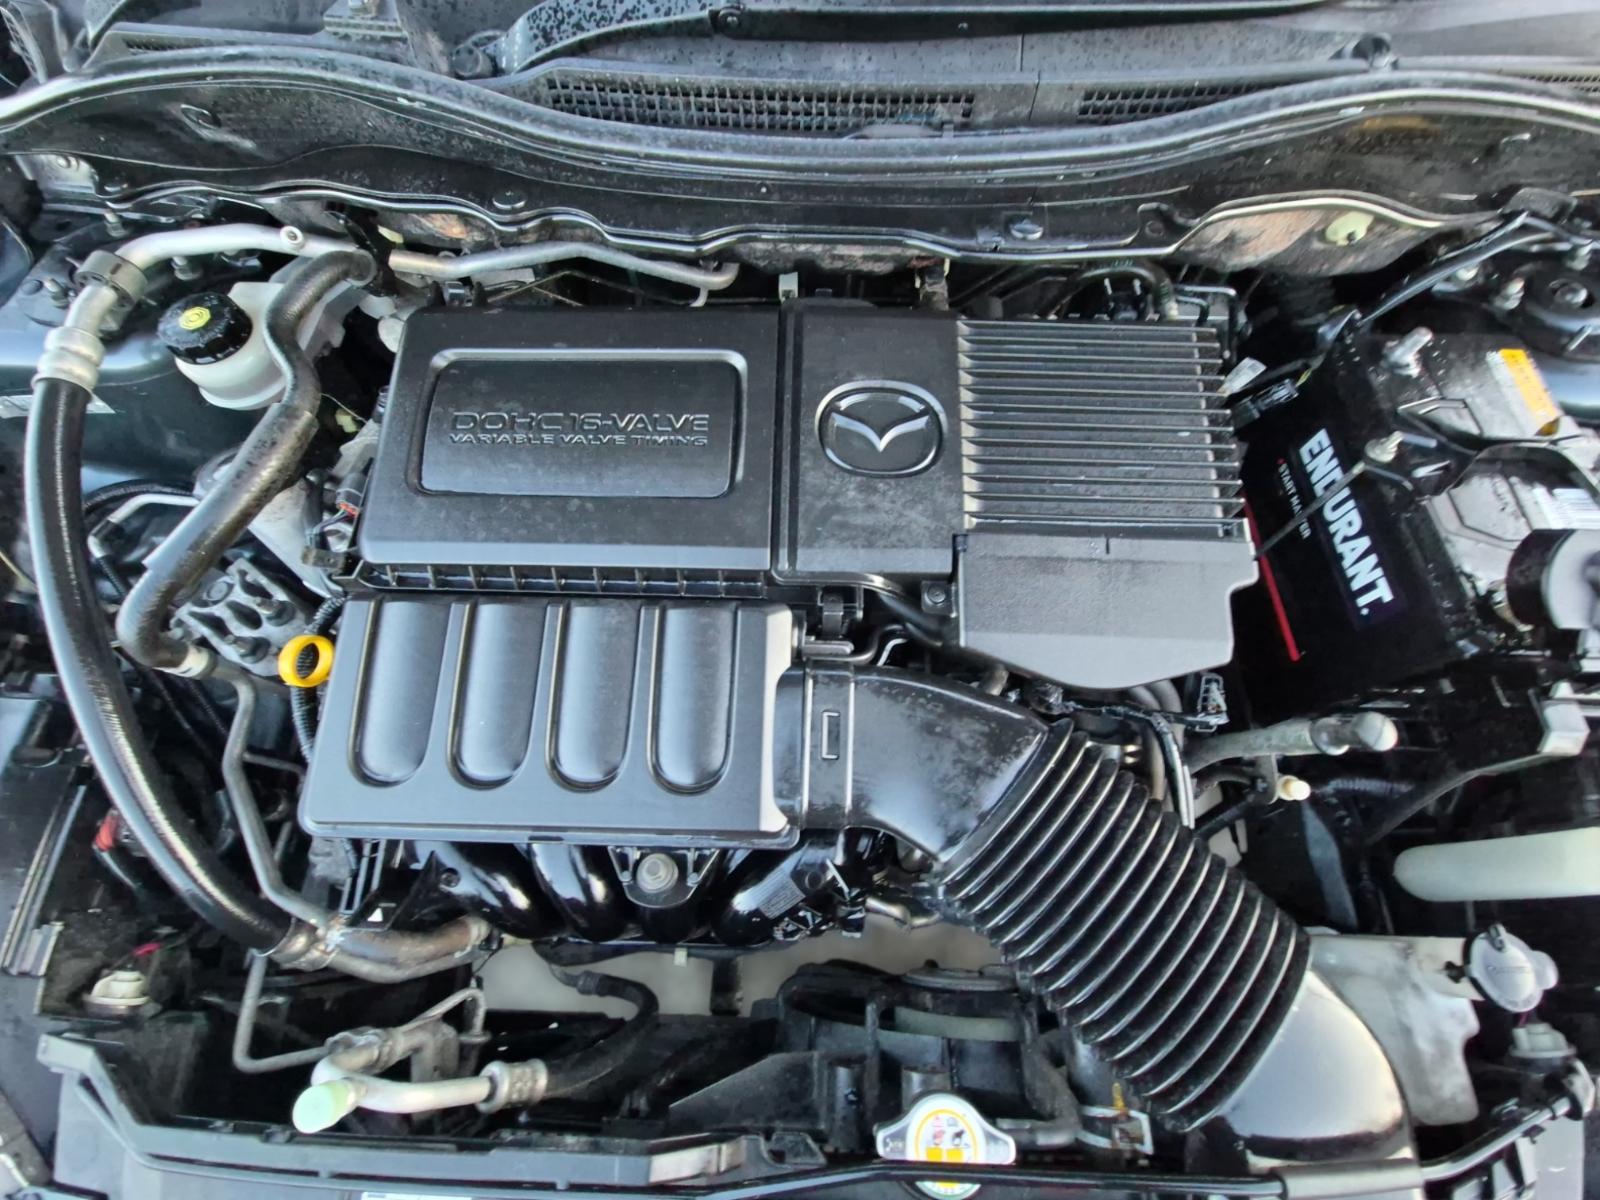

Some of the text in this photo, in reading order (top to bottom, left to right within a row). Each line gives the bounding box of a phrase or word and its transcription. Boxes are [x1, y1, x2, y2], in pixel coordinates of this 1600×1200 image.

[452, 411, 710, 433] DOHC 16-VALVE
[449, 432, 709, 447] VARIABLE VALVE TIMING
[1278, 463, 1312, 540] START MAER
